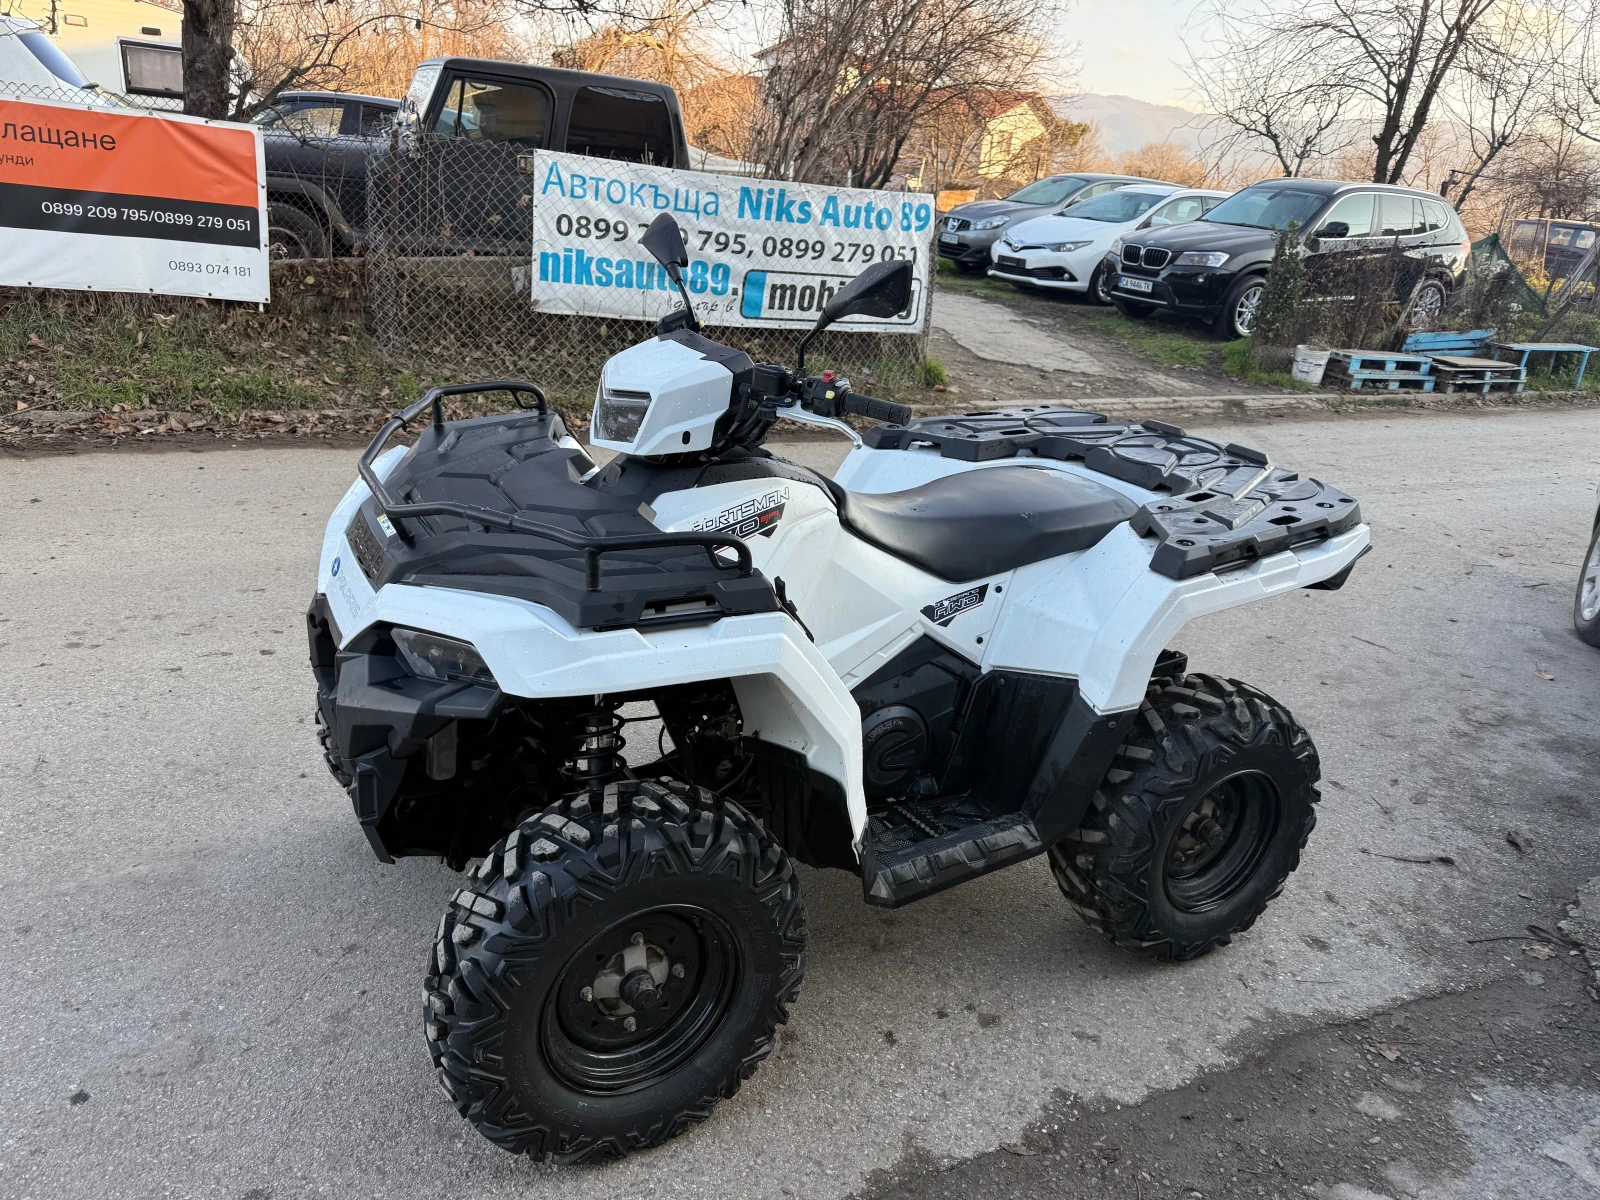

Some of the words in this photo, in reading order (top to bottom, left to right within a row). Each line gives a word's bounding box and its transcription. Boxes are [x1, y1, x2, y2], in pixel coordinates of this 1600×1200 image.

[2, 122, 116, 151] лащане
[541, 161, 719, 221] Автокъща
[738, 186, 812, 225] Niks
[819, 195, 893, 231] Auto
[900, 201, 931, 232] 89
[41, 201, 83, 216] 0899
[87, 205, 117, 219] 209
[120, 208, 193, 226] 795/0899
[197, 215, 223, 229] 279
[226, 218, 251, 232] 051
[555, 213, 629, 242] 0899
[698, 229, 754, 258] 795,
[762, 235, 826, 260] 0899
[831, 241, 875, 264] 279
[881, 245, 917, 265] 051
[168, 260, 202, 273] 0893
[206, 263, 230, 275] 074
[233, 266, 251, 277] 181
[691, 487, 790, 532] PORTSMAN
[934, 593, 980, 620] AWD
